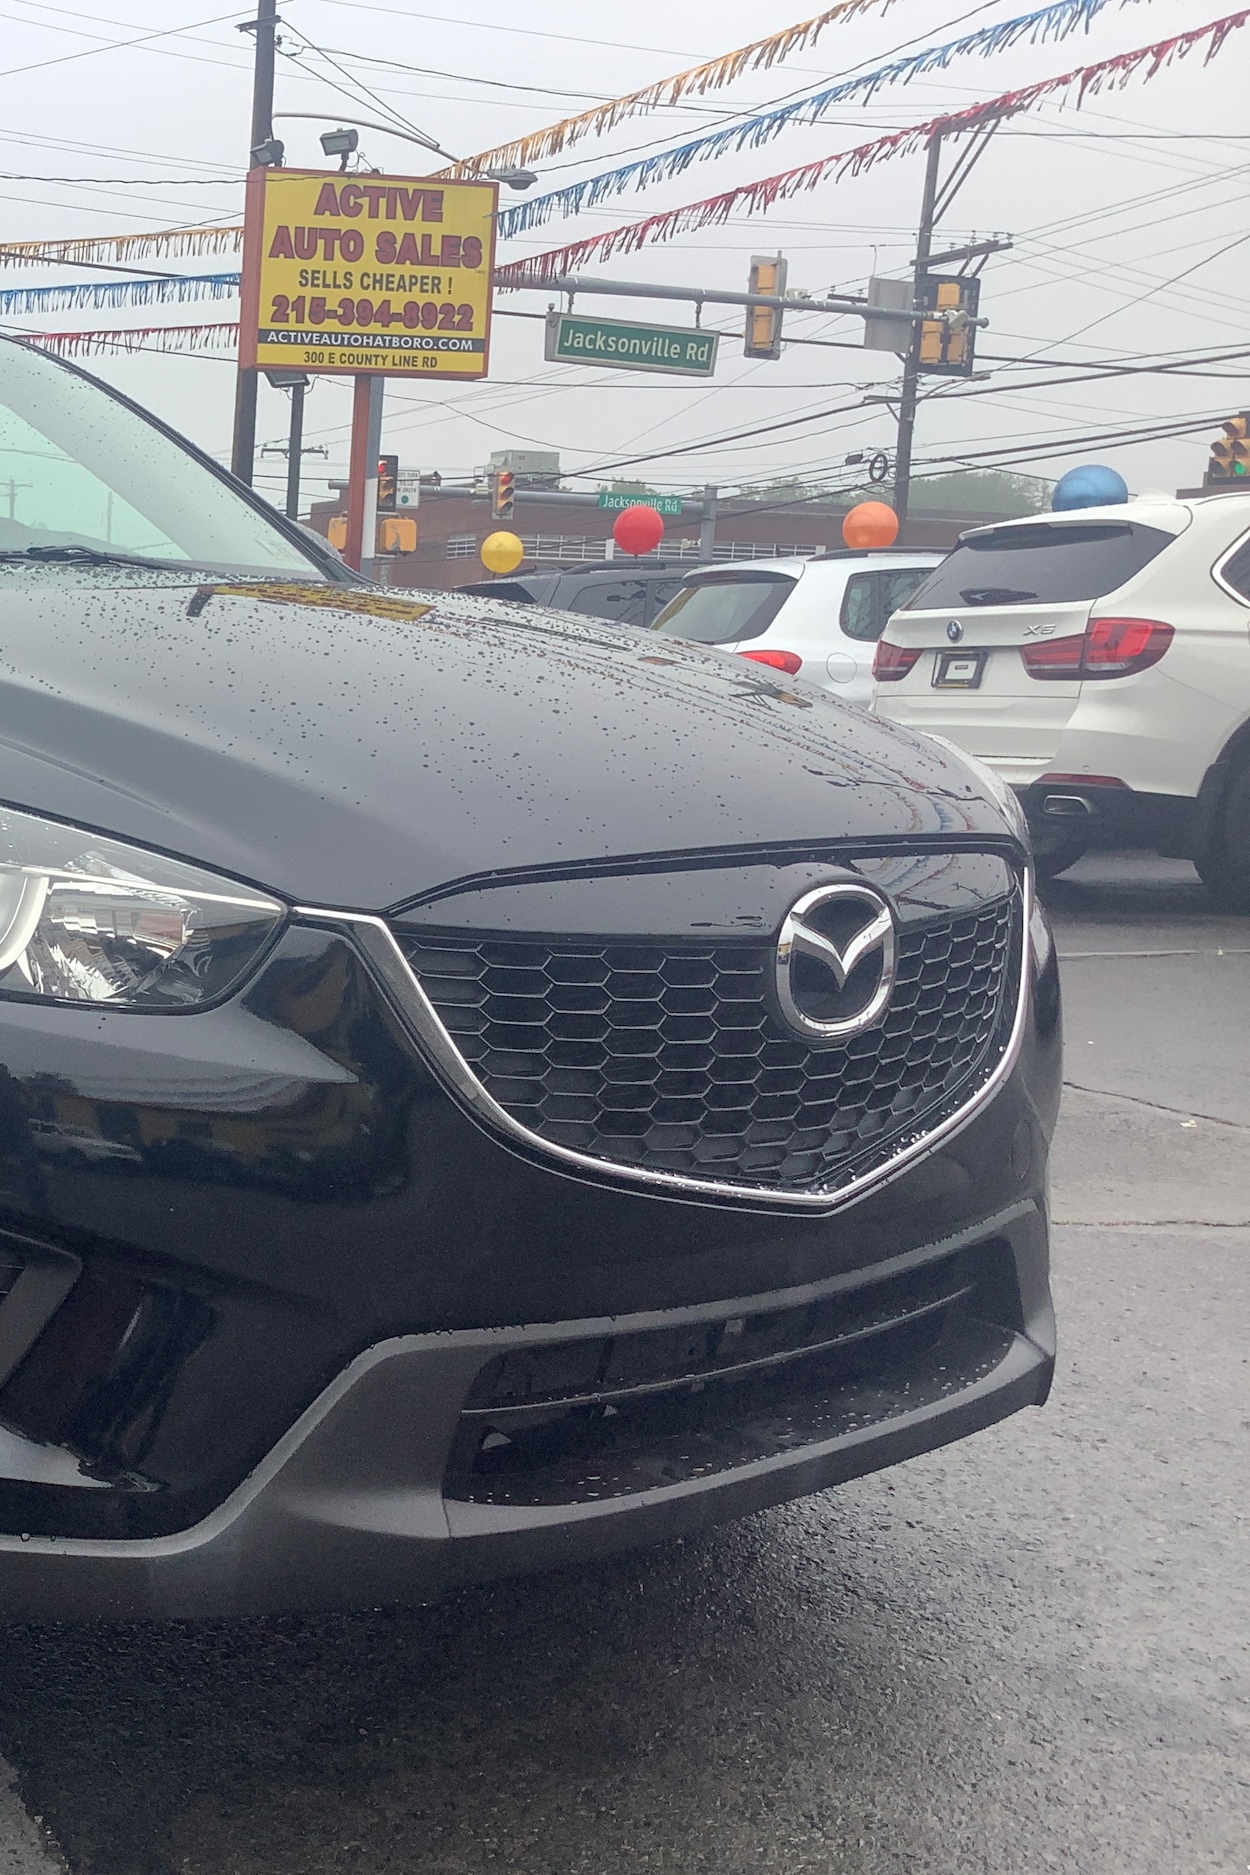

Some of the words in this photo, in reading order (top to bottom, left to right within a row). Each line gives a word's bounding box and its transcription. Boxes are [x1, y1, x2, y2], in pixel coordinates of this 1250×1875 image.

[313, 183, 444, 223] ACTIVE
[268, 225, 364, 263] AUTO
[375, 231, 483, 269] SALES
[298, 269, 353, 290] SELLS
[360, 272, 441, 294] CHEAPER
[270, 294, 474, 332] 215-394-8922
[267, 331, 473, 351] ACTIVEAUTOHATBORO.COM
[563, 329, 681, 359] Jacksonville
[685, 343, 710, 362] Rd
[303, 351, 325, 364] 300
[328, 352, 336, 364] E
[339, 352, 389, 366] COUNTY
[392, 354, 417, 368] LINE
[422, 355, 437, 368] RD
[664, 499, 678, 512] Rd
[1023, 624, 1056, 636] X5
